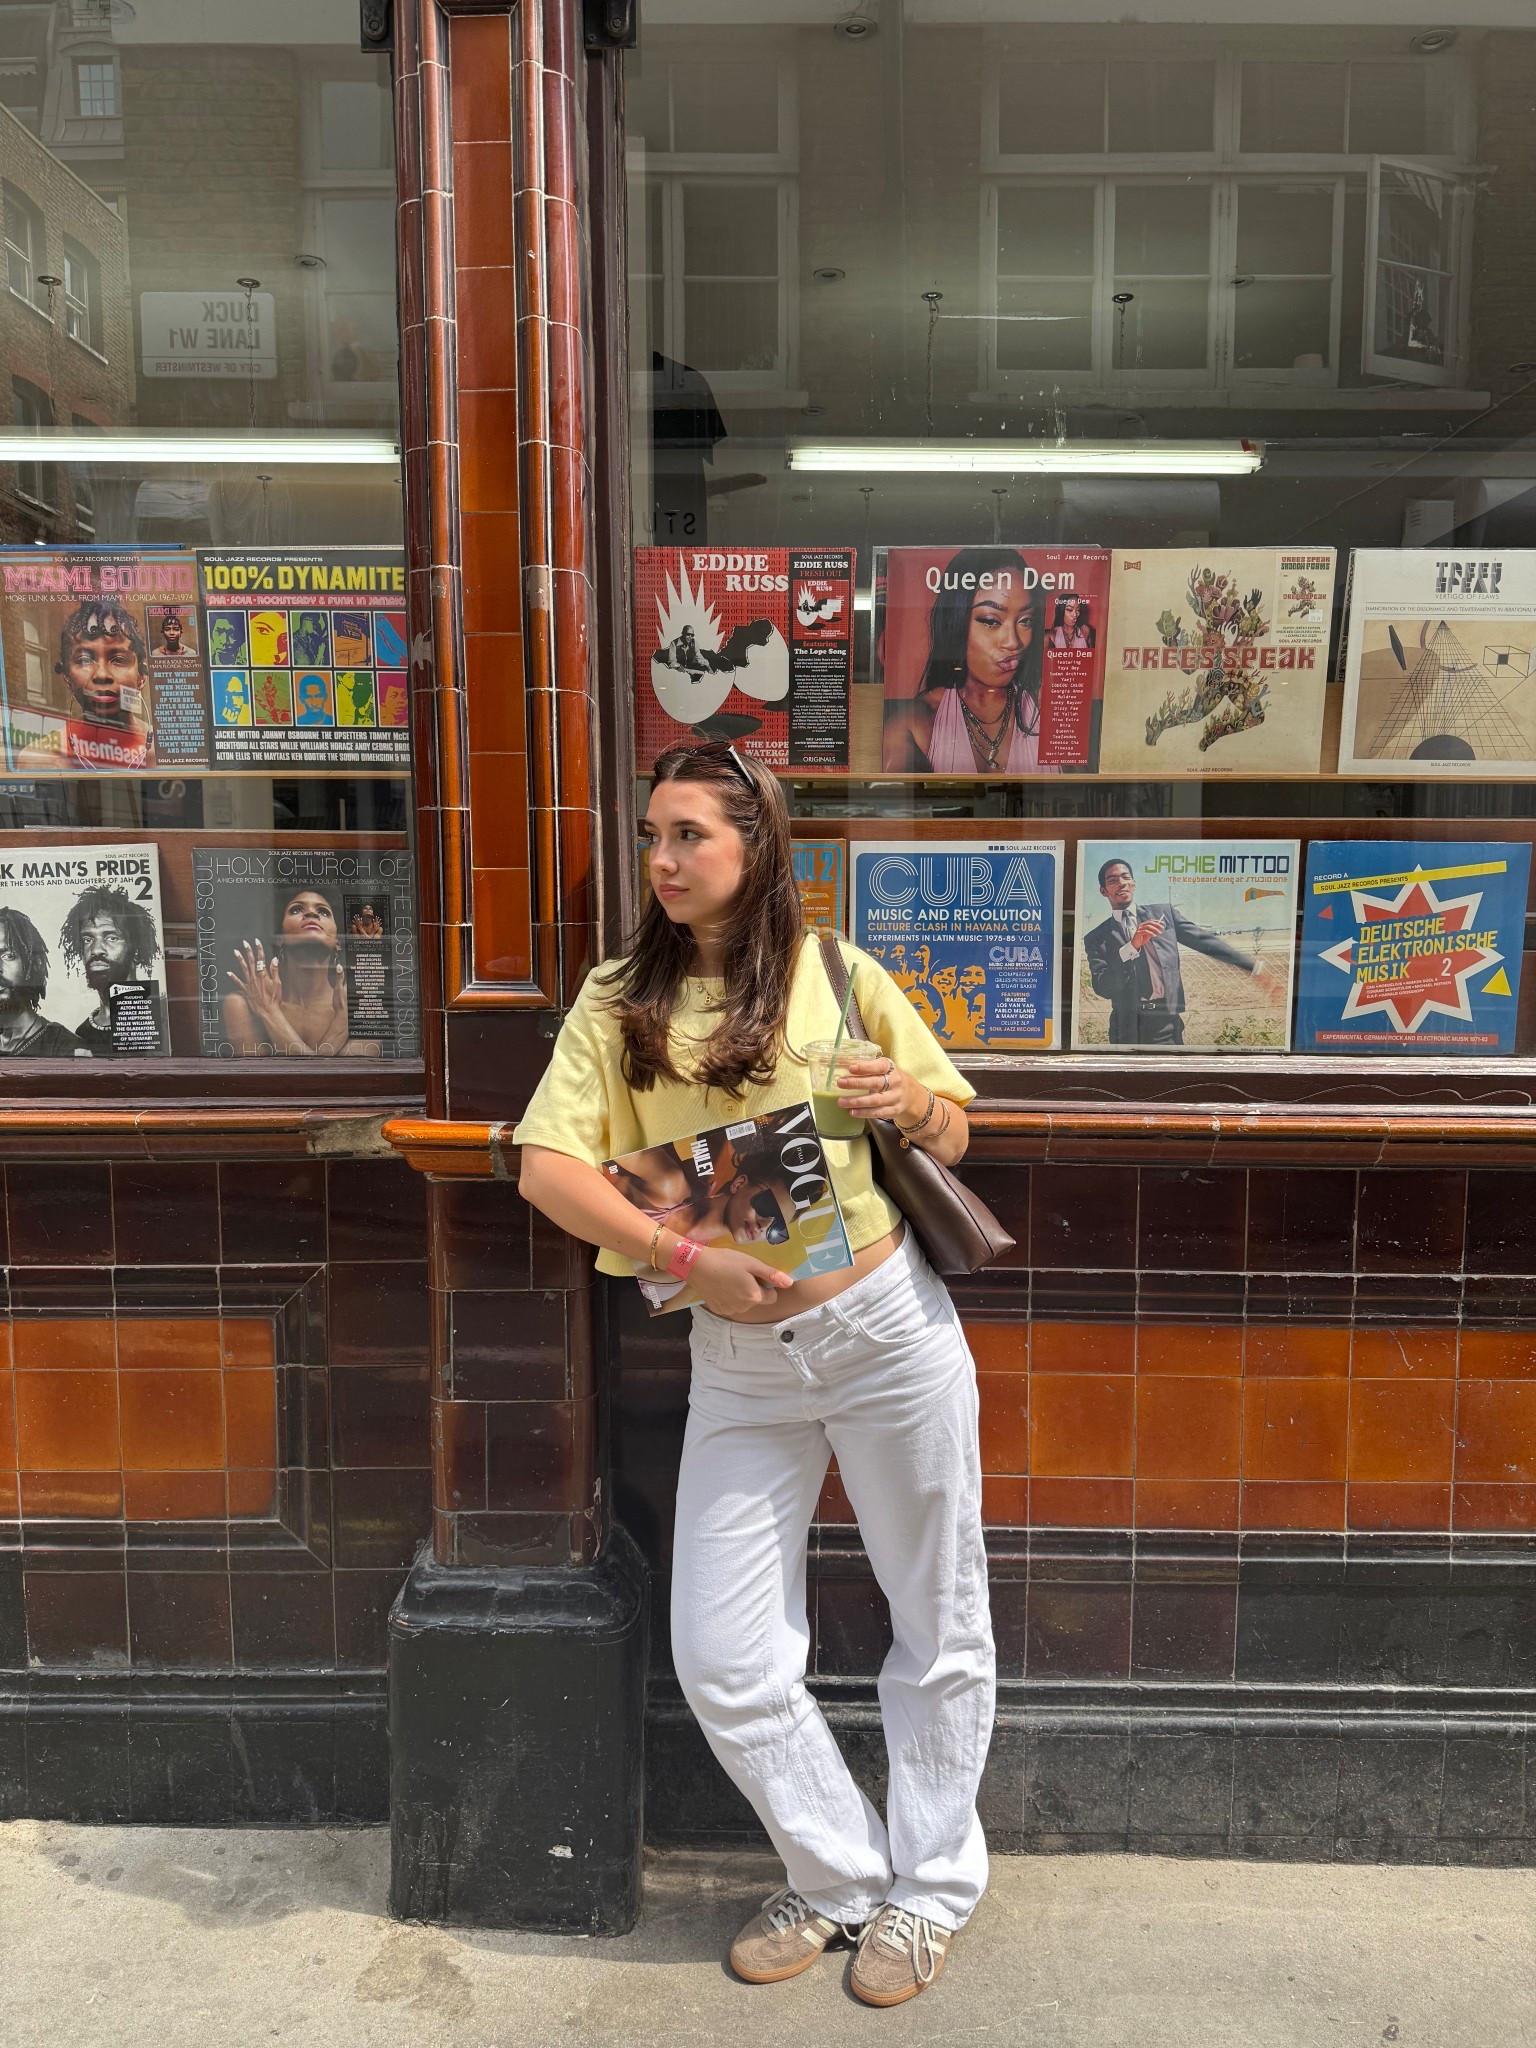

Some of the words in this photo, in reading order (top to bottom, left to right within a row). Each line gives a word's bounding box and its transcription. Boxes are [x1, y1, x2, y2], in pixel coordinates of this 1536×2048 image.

[693, 554, 768, 572] EDDIE
[1435, 562, 1502, 578] TREES
[3, 566, 91, 592] MIAMI
[100, 566, 193, 592] SOUND
[203, 566, 273, 590] 100%
[277, 566, 405, 590] DYNAMITE
[726, 575, 788, 592] RUSS
[926, 567, 1012, 593] Queen
[1023, 567, 1075, 590] Dem
[1435, 577, 1500, 593] SPEAK
[6, 594, 27, 602] MORE
[28, 594, 48, 602] FUNK
[50, 594, 55, 602] &
[56, 594, 76, 602] SOUL
[78, 594, 100, 602] FROM
[126, 594, 156, 602] FLORIDA
[159, 594, 193, 602] 1967-1974
[1054, 598, 1076, 606] Queen
[1123, 647, 1216, 670] TREES
[1223, 647, 1316, 670] SPEAK
[215, 731, 236, 739] JACKIE
[238, 731, 260, 739] MITTOO
[262, 731, 286, 739] JOHNNY
[288, 731, 319, 740] OSBOURNE
[321, 731, 332, 740] THE
[334, 731, 367, 740] UPSETTERS
[369, 732, 391, 740] TOMMY
[22, 861, 88, 879] MAN'S
[96, 859, 150, 876] PRIDE
[216, 857, 271, 875] HOLY
[278, 857, 371, 876] CHURCH
[821, 851, 833, 880] 2
[1145, 856, 1215, 873] JACKIE
[1220, 856, 1289, 873] MITTOO
[134, 876, 153, 900] 2
[196, 857, 215, 911] SOUL
[869, 856, 1042, 906] CUBA
[1314, 873, 1342, 882] RECORD
[1337, 882, 1351, 890] JAZZ
[1352, 880, 1378, 888] RECORDS
[1380, 876, 1409, 885] PRESENTS
[394, 875, 412, 911] THE
[868, 909, 913, 921] MUSIC
[917, 909, 950, 921] AND
[954, 909, 1042, 921] REVOLUTION
[868, 923, 910, 931] CULTURE
[913, 923, 948, 931] CLASH
[951, 923, 962, 931] IN
[965, 923, 1008, 931] HAVANA
[1012, 923, 1041, 931] CUBA
[1360, 917, 1446, 944] DEUTSCHE
[989, 946, 1043, 962] CUBA
[1357, 931, 1498, 965] ELEKTRONISCHE
[198, 916, 218, 1003] ECSTATIC
[394, 916, 416, 1003] ECSTATIC
[1441, 958, 1452, 977] 2
[1356, 962, 1411, 984] MUSIK
[202, 1008, 219, 1046] THE
[398, 1009, 416, 1057] SOUL
[690, 1138, 714, 1176] HAILEY
[775, 1107, 848, 1273] VOGUE
